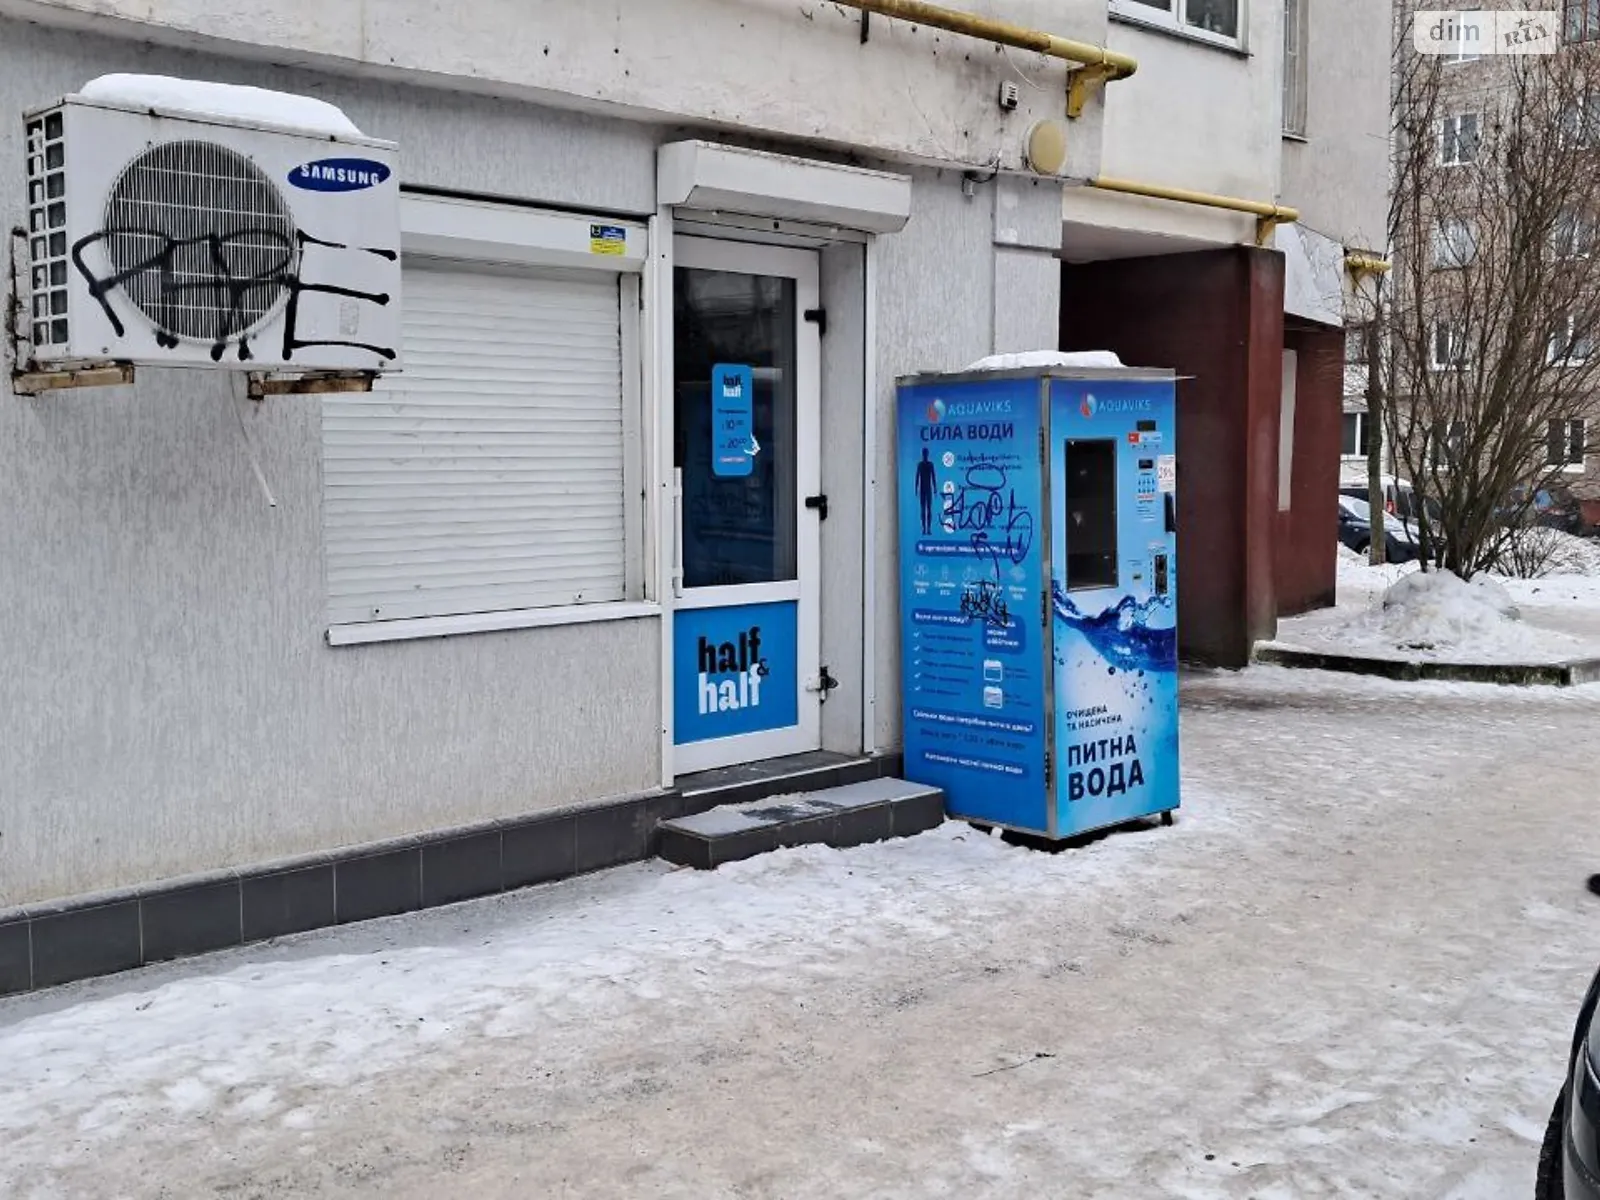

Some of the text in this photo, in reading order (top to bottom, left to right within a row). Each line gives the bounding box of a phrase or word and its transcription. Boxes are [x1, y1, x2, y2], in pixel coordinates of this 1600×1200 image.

[300, 164, 380, 186] SAMSUNG
[947, 400, 1012, 416] AQUAVIKS
[1098, 399, 1152, 412] AQUAVIKS
[920, 422, 1014, 442] СИЛА ВОДИ
[698, 626, 761, 673] half
[698, 663, 761, 714] half
[1066, 704, 1108, 720] ОЧИЩЕНА
[1066, 714, 1123, 732] ТА НАСИЧЕНА
[1068, 734, 1137, 768] ПИТНА
[1068, 759, 1145, 802] ВОДА
